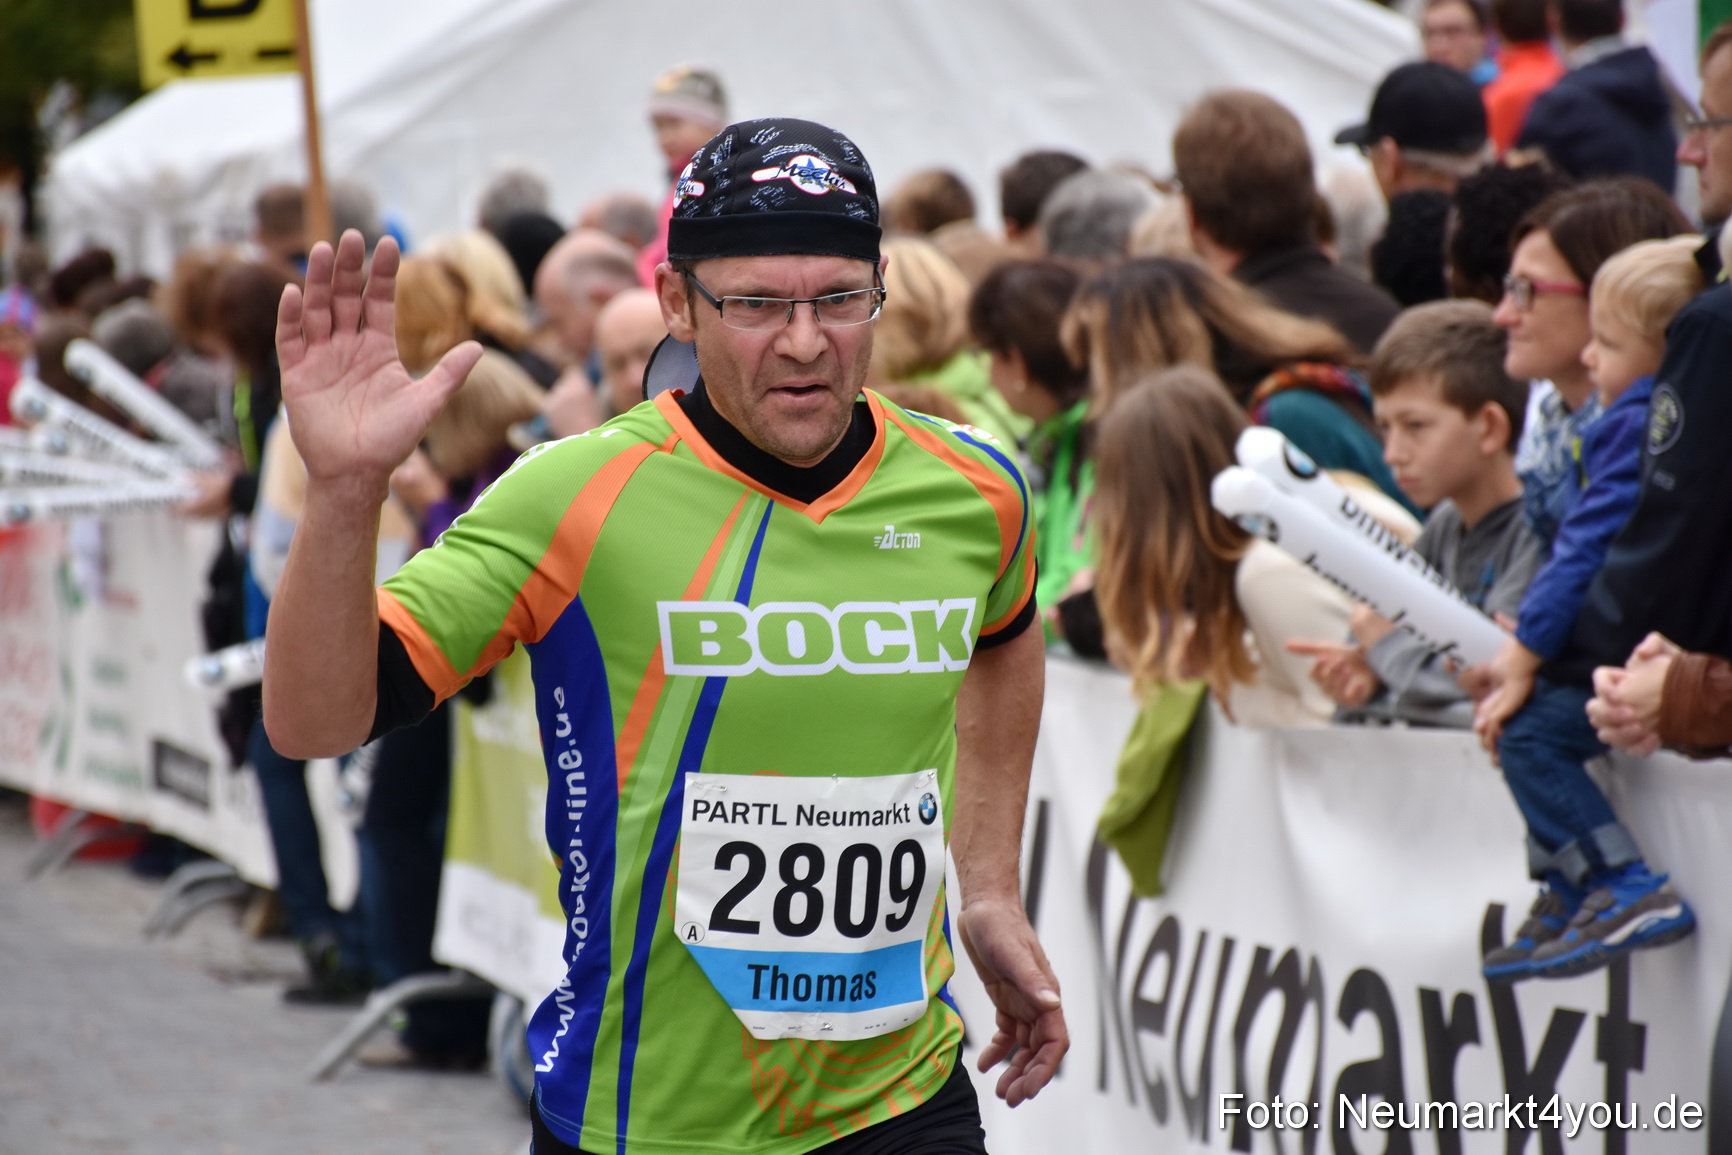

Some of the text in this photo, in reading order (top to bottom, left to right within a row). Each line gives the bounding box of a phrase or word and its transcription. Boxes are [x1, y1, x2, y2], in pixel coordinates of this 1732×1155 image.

[656, 597, 977, 677] BOCK
[692, 799, 911, 827] PARTL Neumarkt
[708, 839, 926, 938] 2809
[687, 925, 698, 941] A
[747, 964, 876, 1002] Thomas
[1087, 828, 1648, 1155] Neumarkt
